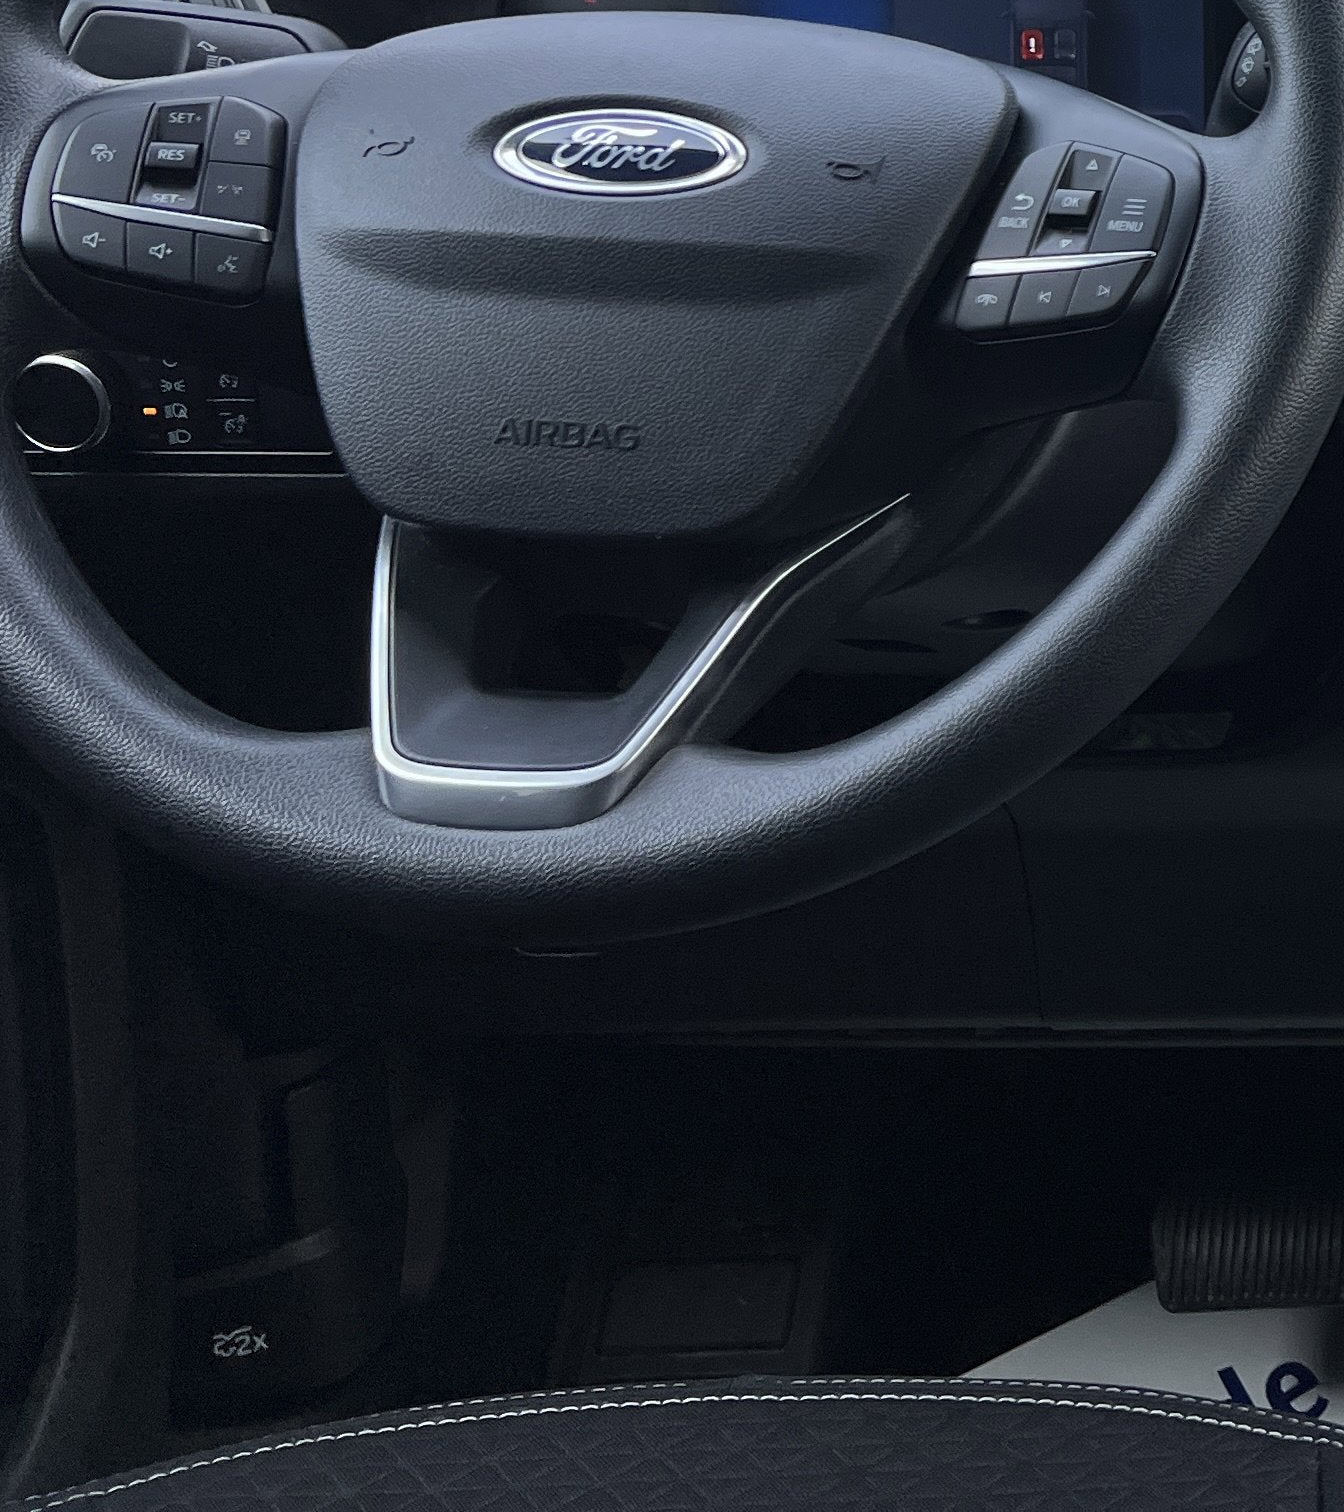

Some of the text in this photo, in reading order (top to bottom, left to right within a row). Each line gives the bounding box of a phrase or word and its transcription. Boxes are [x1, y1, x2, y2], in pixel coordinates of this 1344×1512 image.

[157, 148, 186, 161] RES
[551, 124, 686, 173] Ford
[1061, 195, 1081, 208] OK
[997, 216, 1030, 229] BACK
[1106, 219, 1145, 233] MENU
[494, 417, 643, 451] AIRBAG
